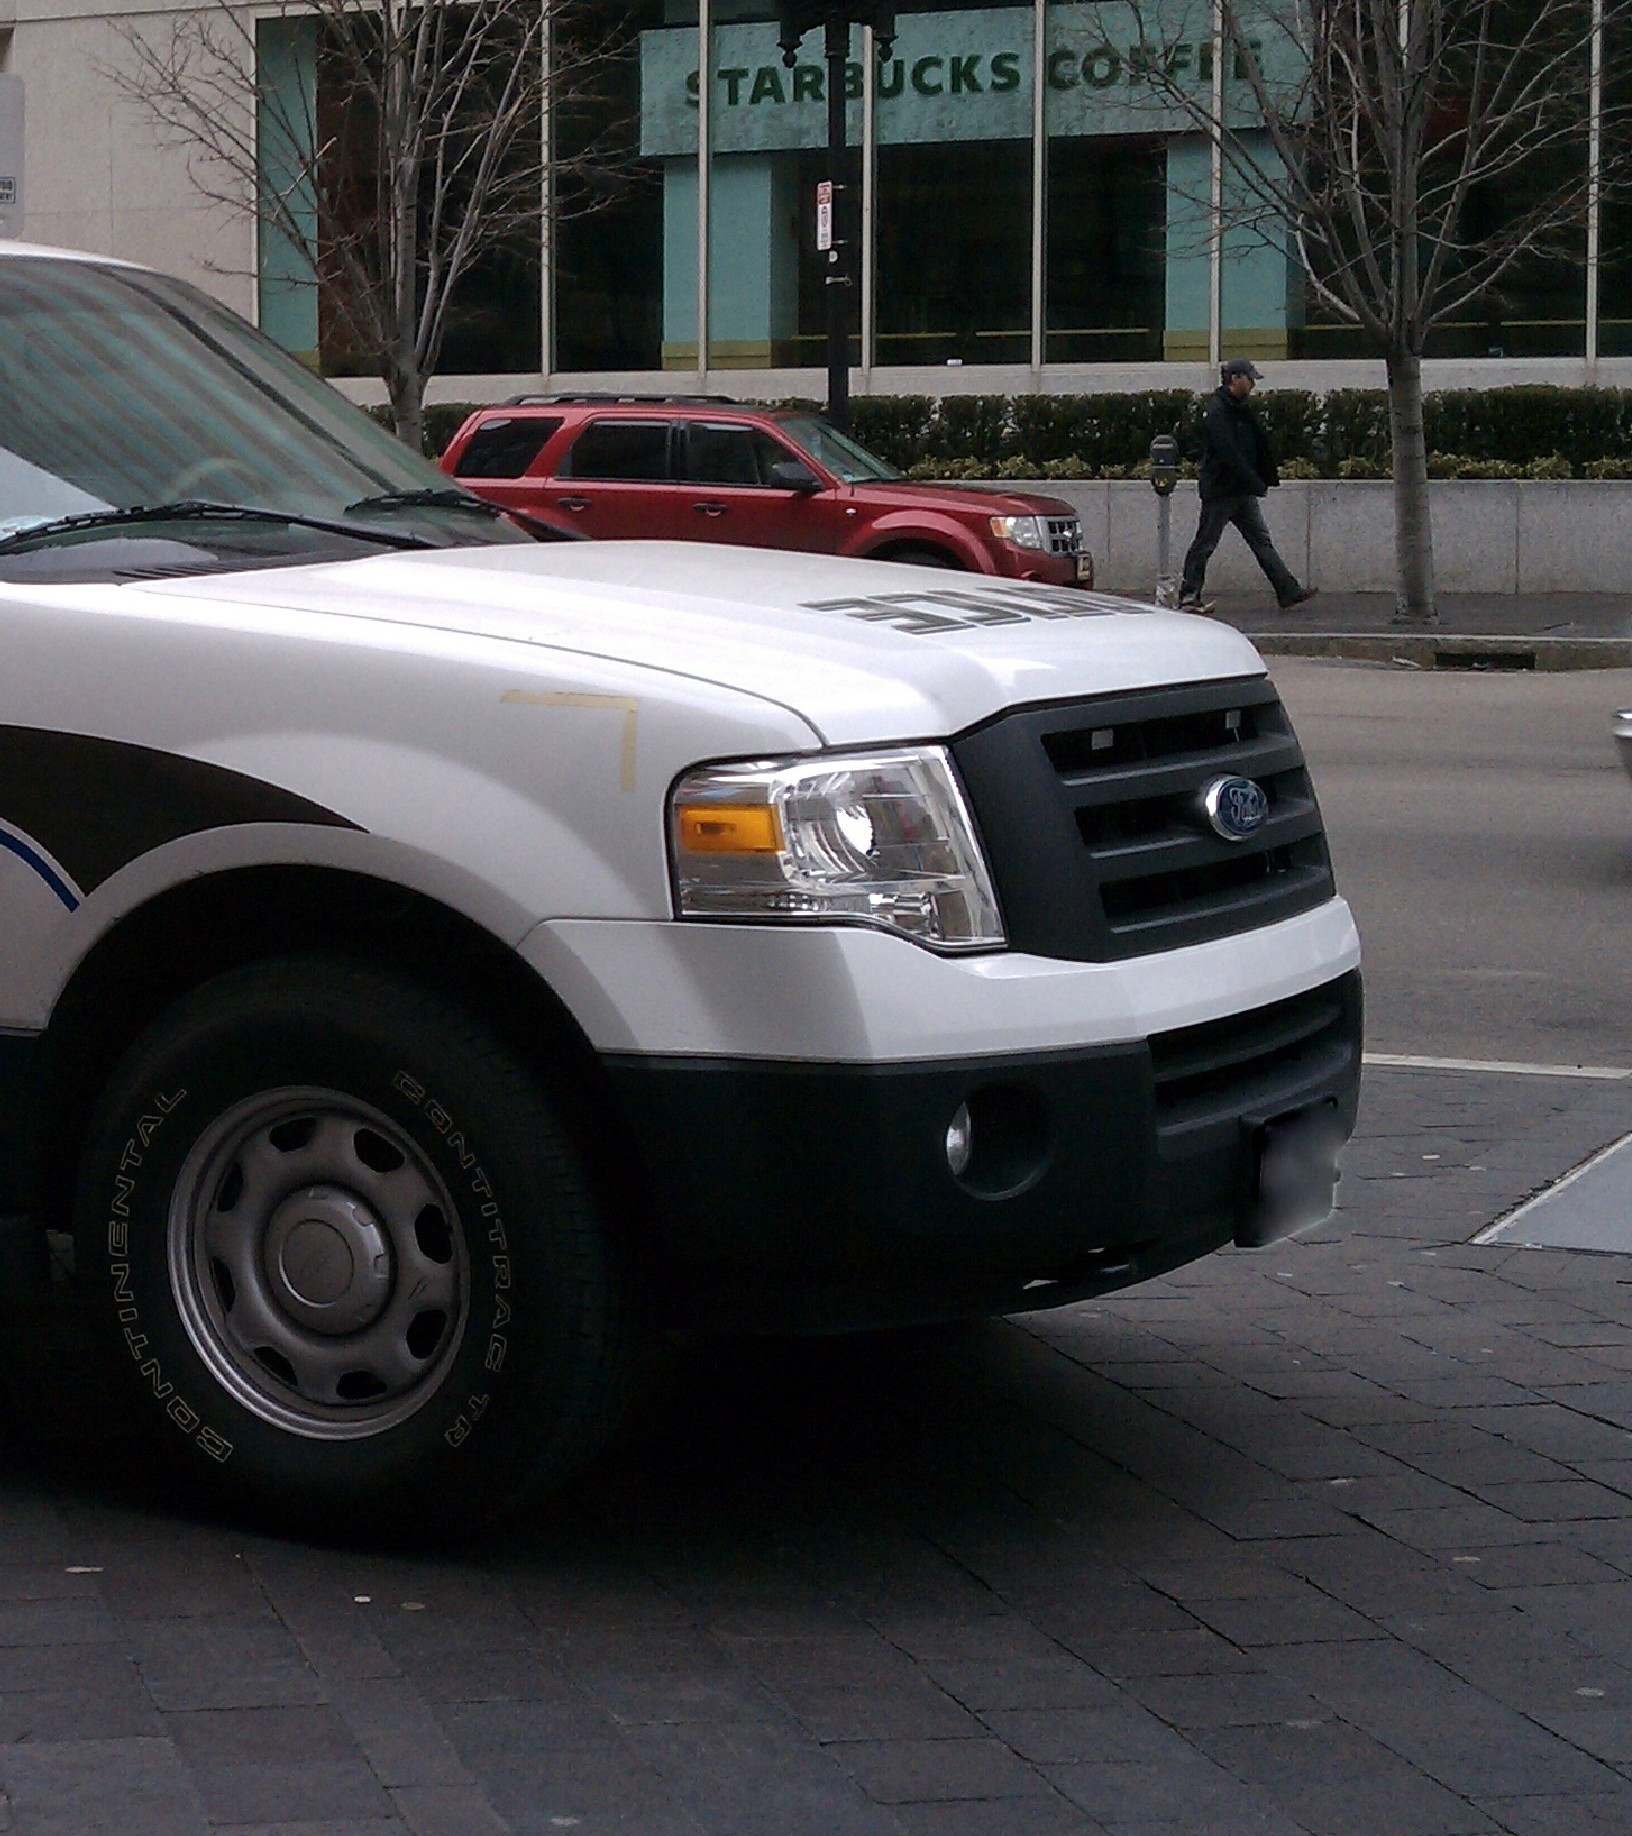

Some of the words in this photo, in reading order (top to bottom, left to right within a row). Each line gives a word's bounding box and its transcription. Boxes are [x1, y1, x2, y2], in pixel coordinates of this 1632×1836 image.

[686, 55, 1022, 106] STARBUCKS
[108, 1089, 234, 1463] CONTINENTAL
[394, 1070, 512, 1373] CONTITRAC
